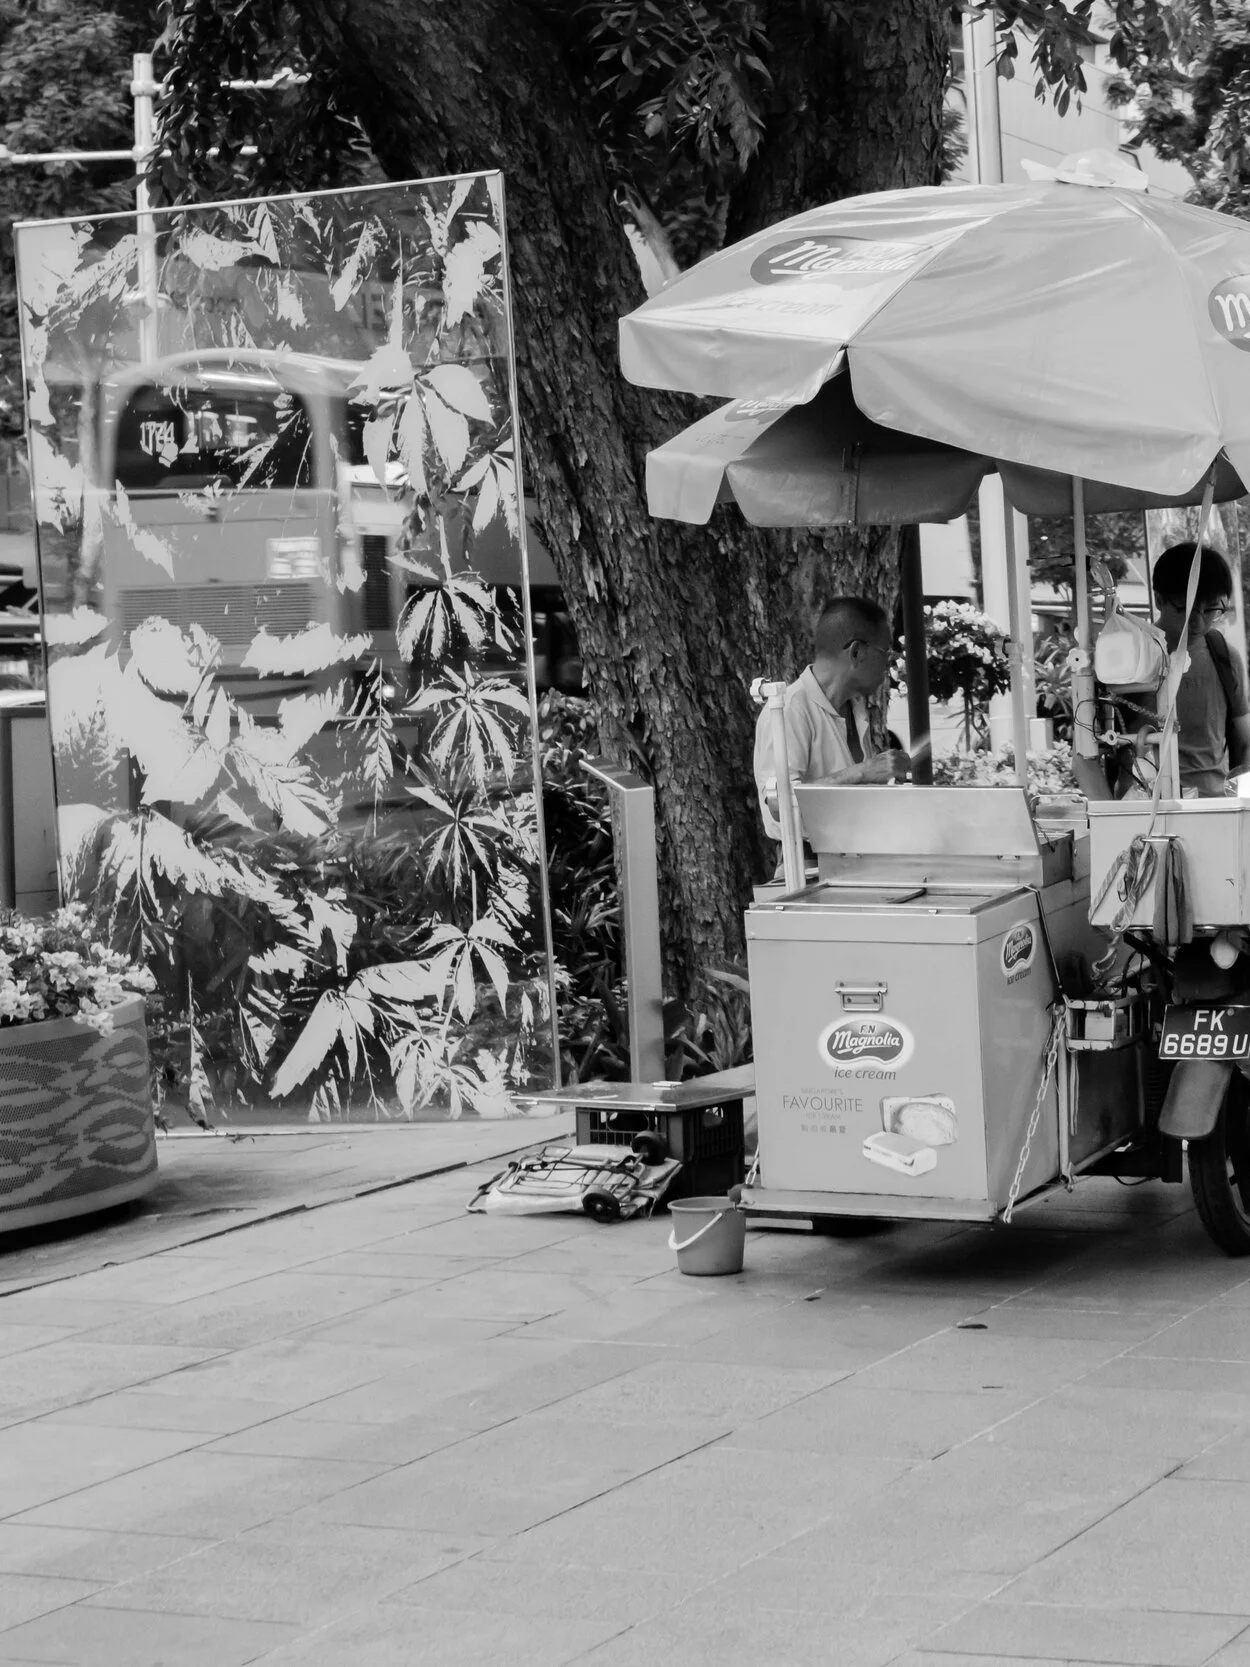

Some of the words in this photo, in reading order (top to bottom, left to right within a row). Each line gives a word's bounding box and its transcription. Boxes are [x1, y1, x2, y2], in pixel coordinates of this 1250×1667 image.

[1193, 1009, 1226, 1032] FK
[832, 1030, 901, 1055] Magnolia
[1163, 1033, 1229, 1056] 6689
[1232, 1033, 1249, 1055] U
[834, 1065, 853, 1079] ice
[855, 1069, 898, 1081] cream
[782, 1094, 865, 1113] FAVOURITE
